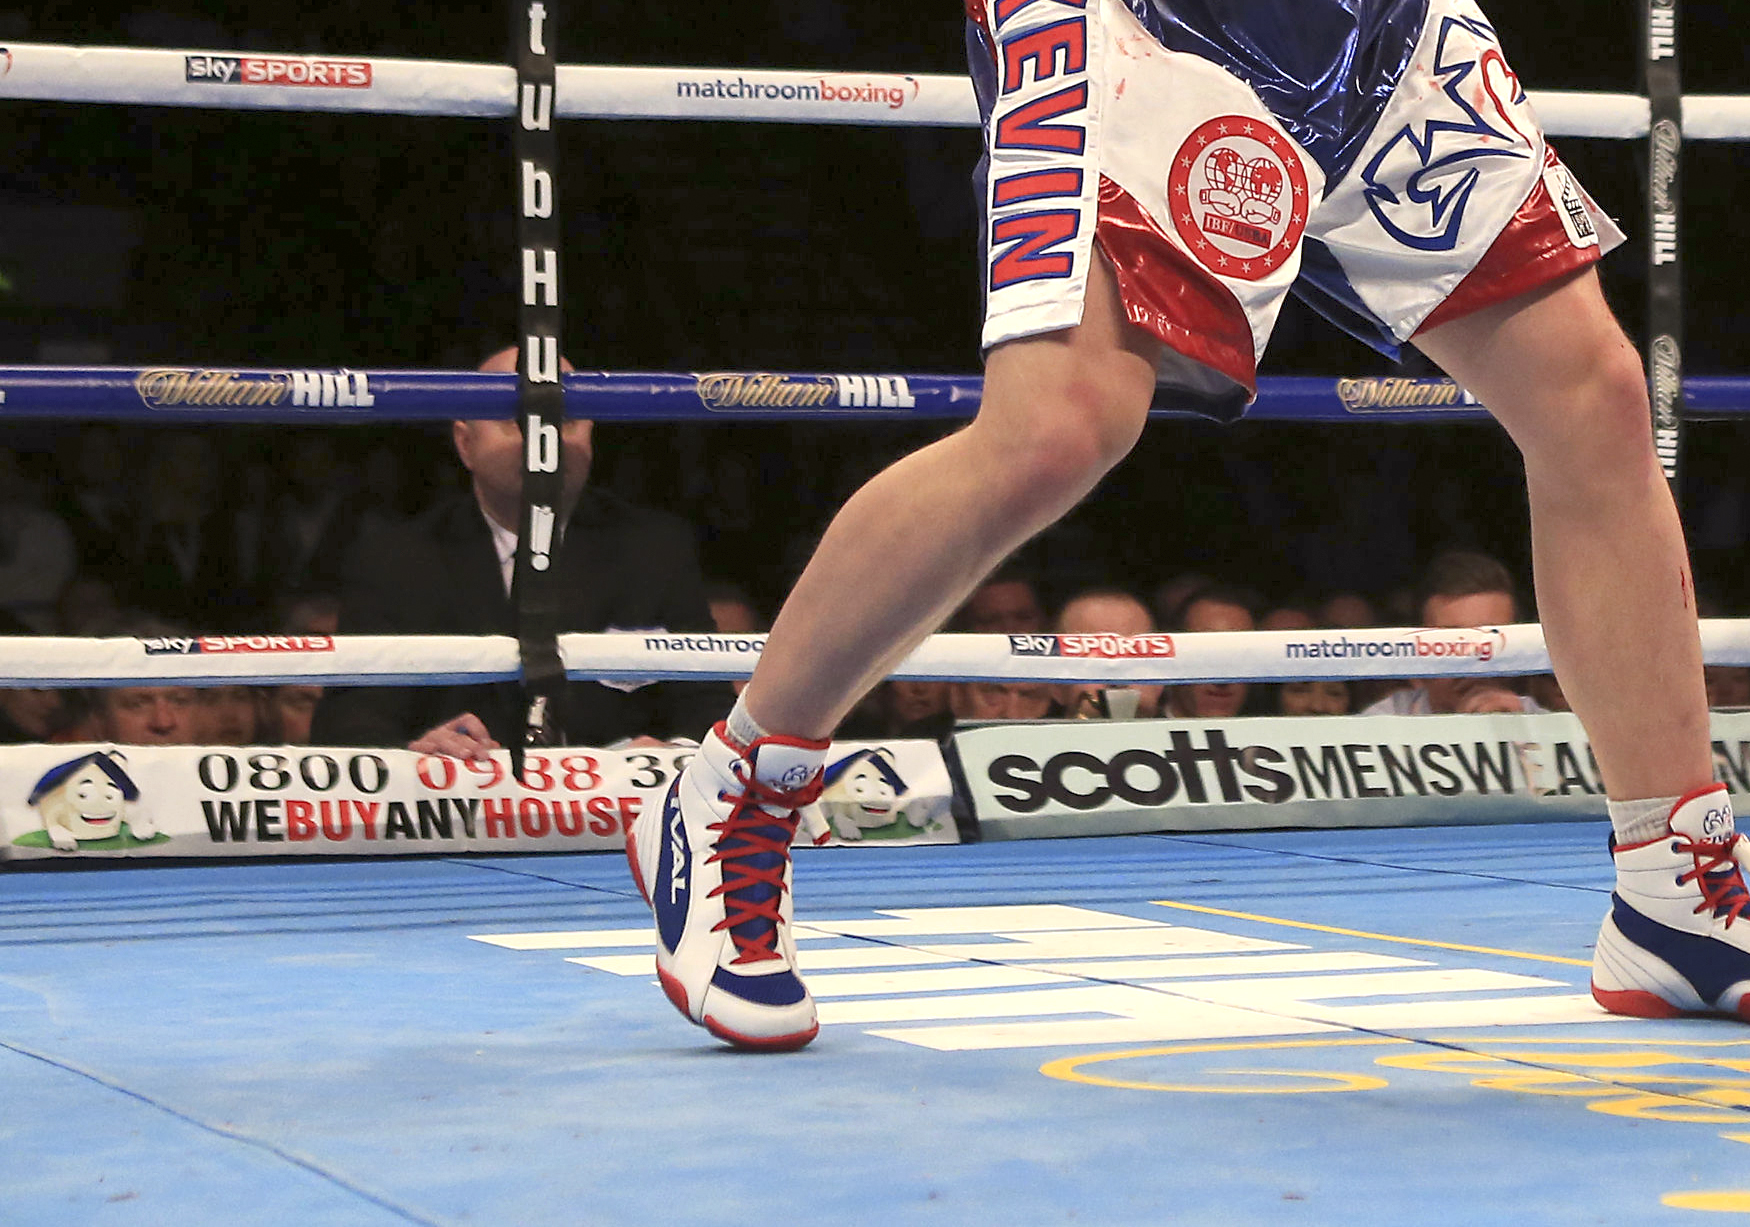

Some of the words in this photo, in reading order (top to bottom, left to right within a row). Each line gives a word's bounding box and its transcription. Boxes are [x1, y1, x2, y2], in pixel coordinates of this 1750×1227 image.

[1651, 7, 1675, 61] HILL
[188, 56, 238, 84] sky
[244, 61, 368, 85] SPORTS
[1652, 213, 1676, 265] HILL
[134, 369, 293, 410] William
[291, 369, 375, 408] HILL
[700, 374, 840, 410] William
[838, 375, 915, 408] HILL
[1337, 377, 1458, 411] William
[145, 637, 193, 654] sky
[202, 635, 332, 651] SPORTS
[644, 635, 766, 653] matchroo
[1010, 635, 1056, 656] sky
[1063, 635, 1172, 656] SPORTS
[1286, 635, 1494, 661] matchroomboxing
[199, 753, 389, 793] 0800
[201, 796, 643, 842] WEBUYANYHOUSE
